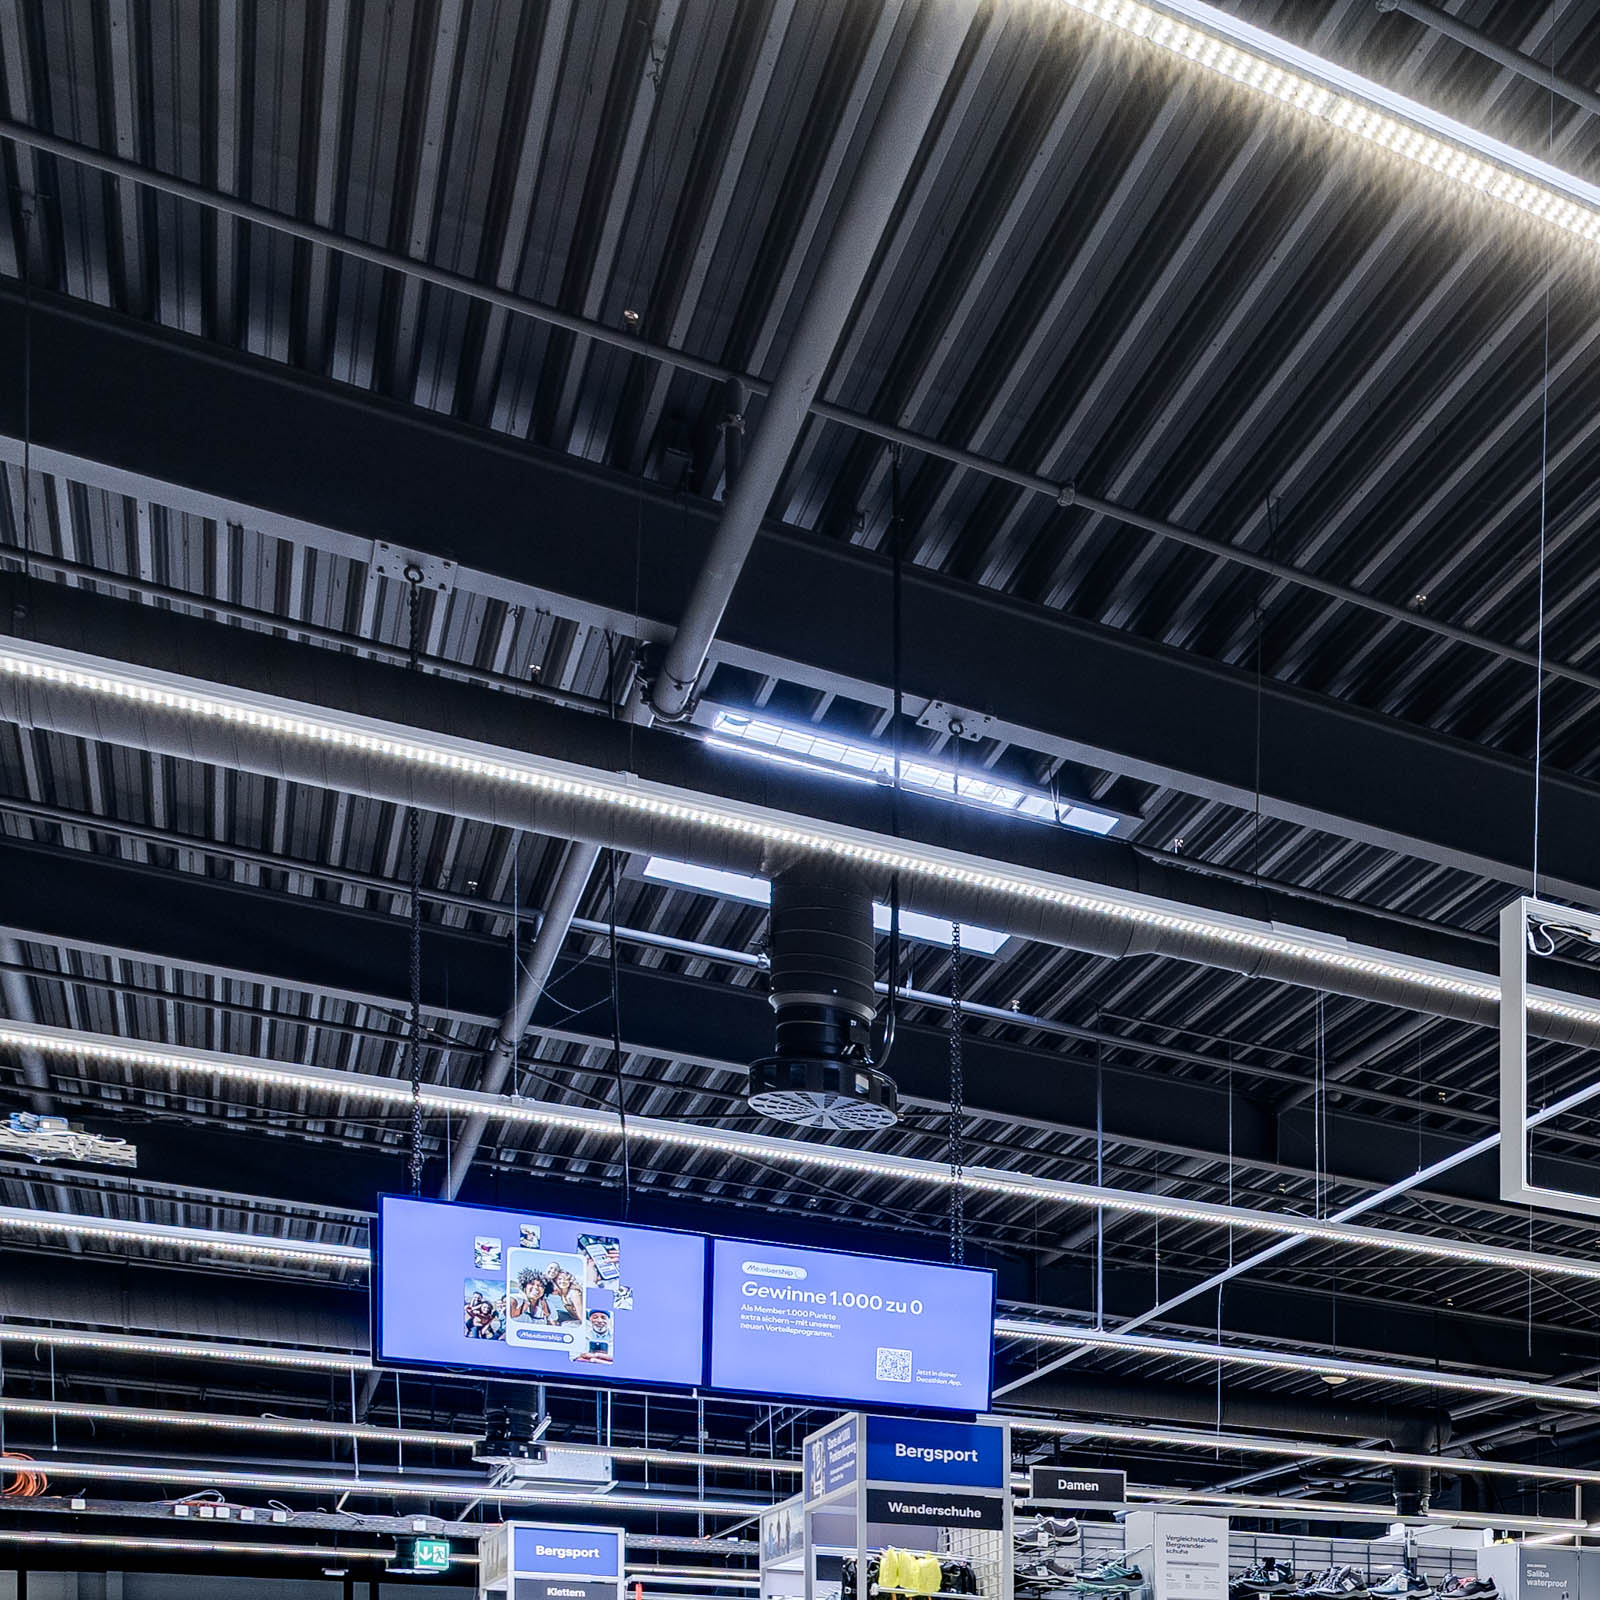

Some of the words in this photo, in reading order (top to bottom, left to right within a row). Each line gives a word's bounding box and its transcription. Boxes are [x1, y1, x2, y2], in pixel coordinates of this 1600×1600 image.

[741, 1281, 827, 1305] Gewinne
[829, 1291, 883, 1311] 1.000
[885, 1300, 907, 1314] zu
[910, 1299, 923, 1315] 0
[754, 1305, 786, 1316] Member
[809, 1311, 837, 1320] Punkte
[895, 1443, 978, 1464] Bergsport
[1058, 1478, 1099, 1492] Damen
[888, 1501, 982, 1519] Wanderschuhe
[1166, 1535, 1218, 1544] Vergleichstabelle
[536, 1545, 600, 1559] Bergsport
[547, 1587, 585, 1597] Klettern
